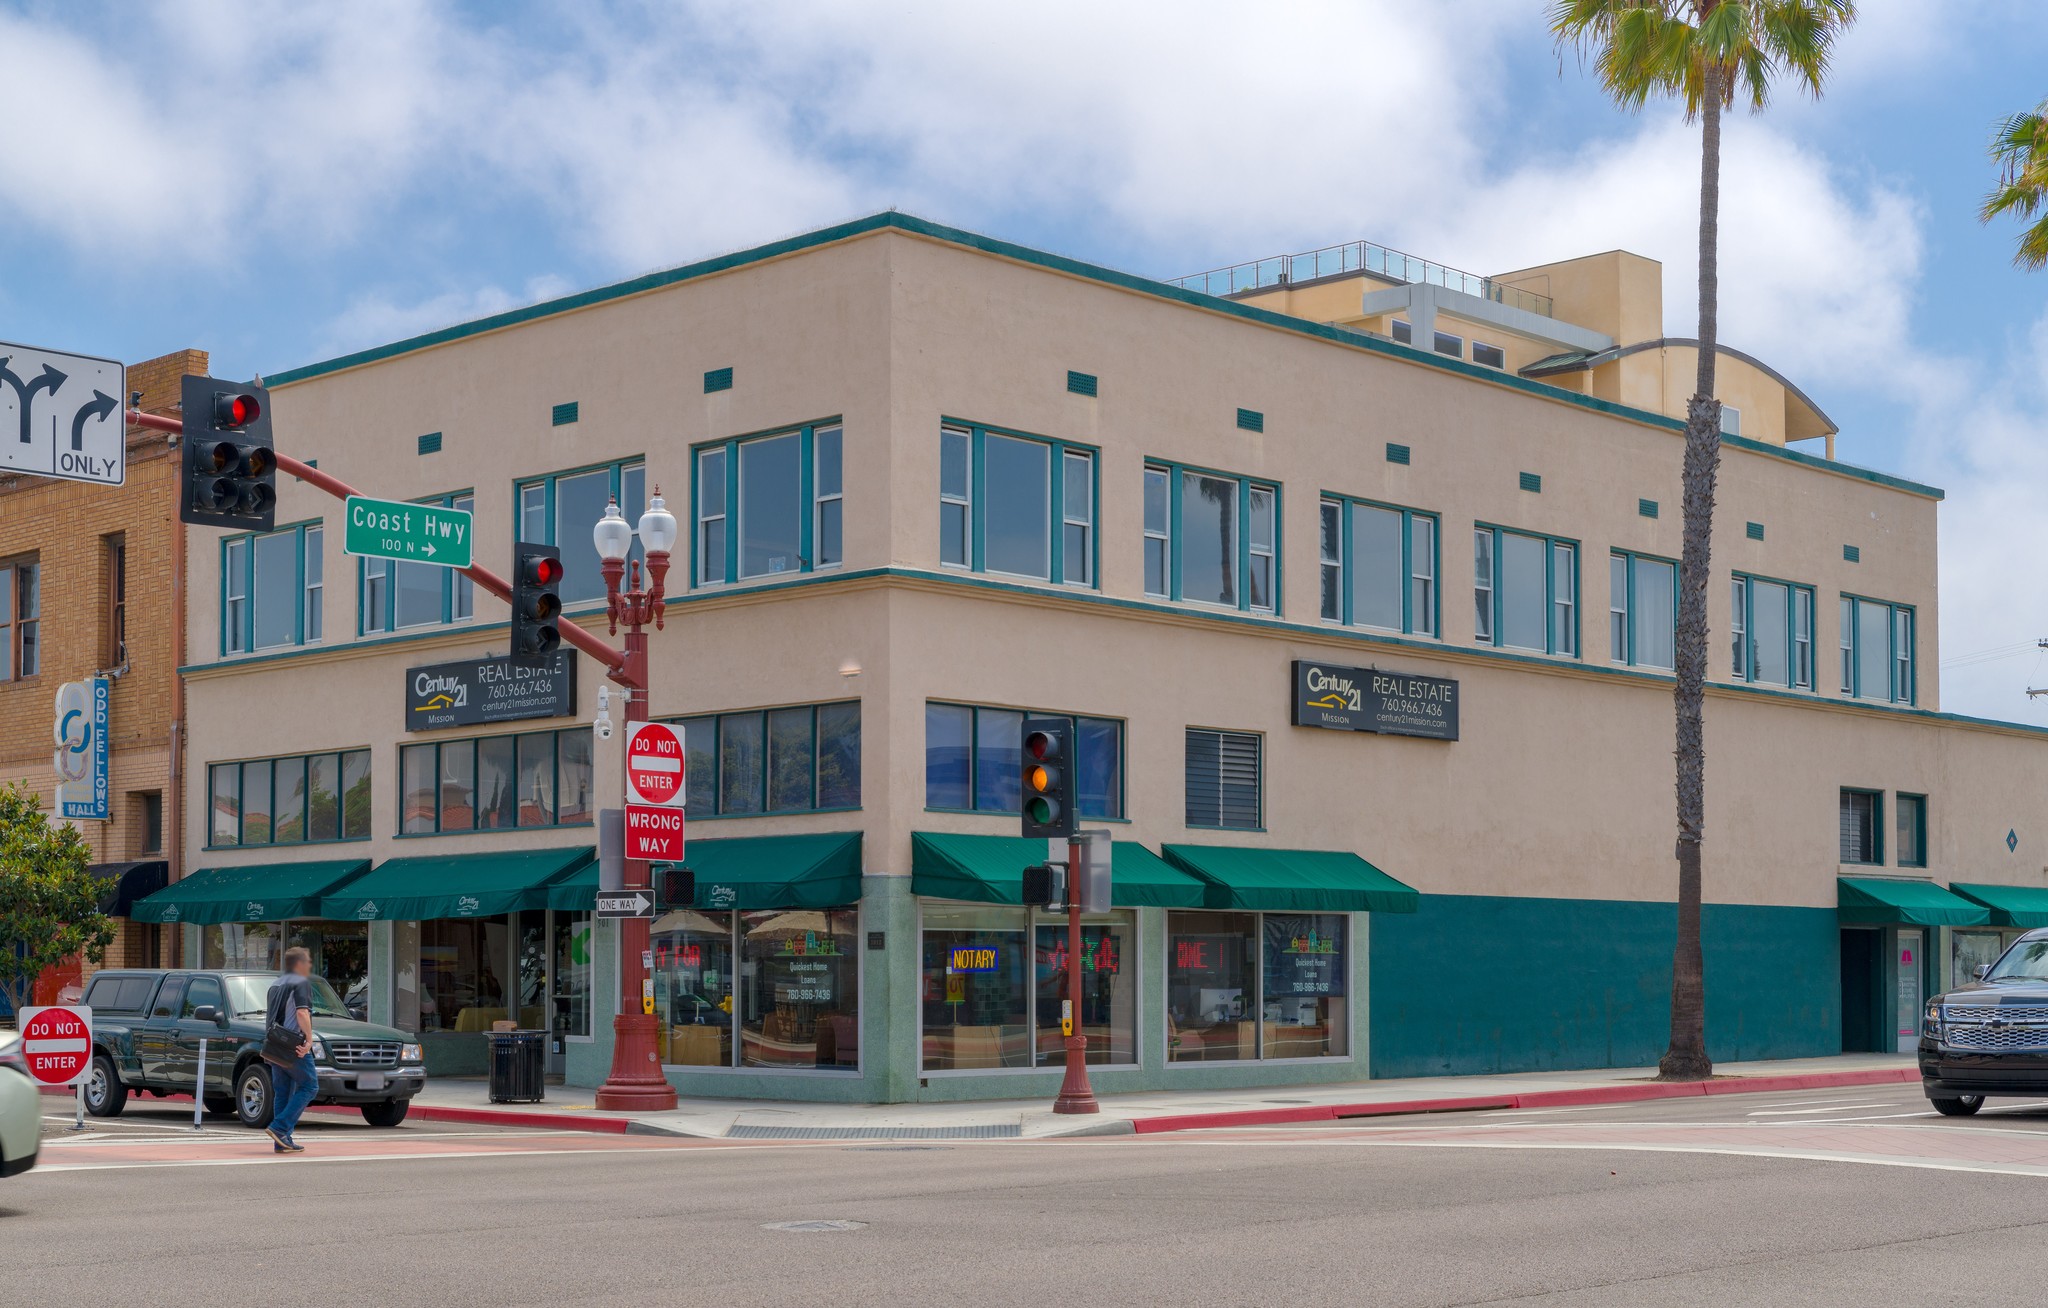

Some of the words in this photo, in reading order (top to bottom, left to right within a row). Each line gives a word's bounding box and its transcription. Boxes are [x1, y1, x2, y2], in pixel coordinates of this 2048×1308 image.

[60, 453, 116, 477] ONLY
[353, 506, 410, 533] Coast
[425, 515, 465, 545] Hwy
[382, 538, 401, 552] 100
[406, 541, 414, 553] N
[478, 663, 511, 684] REAL
[415, 672, 458, 697] Century
[454, 683, 467, 707] 21
[488, 679, 552, 699] 760.966.7436
[1306, 667, 1353, 696] Century
[1348, 689, 1361, 712] 21
[1372, 676, 1405, 697] REAL
[1409, 680, 1452, 702] ESTATE
[95, 687, 107, 724] ODD
[482, 695, 557, 713] century21mission.com
[1381, 697, 1443, 717] 760.966.7436
[1376, 712, 1447, 728] century21mission.com
[635, 738, 650, 751] DO
[657, 739, 677, 754] NOT
[95, 729, 107, 813] FELLOWS
[639, 775, 673, 789] ENTER
[68, 804, 97, 816] HALL
[629, 812, 681, 831] WRONG
[639, 837, 670, 853] WAY
[600, 900, 616, 910] ONE
[619, 900, 637, 910] WAY
[789, 961, 812, 972] Quickest
[812, 962, 828, 971] Home
[953, 949, 996, 969] NOTARY
[801, 975, 816, 984] Loans
[786, 989, 831, 1000] 760-966-7436
[31, 1023, 49, 1036] DO
[56, 1022, 81, 1035] NOT
[36, 1056, 76, 1070] ENTER
